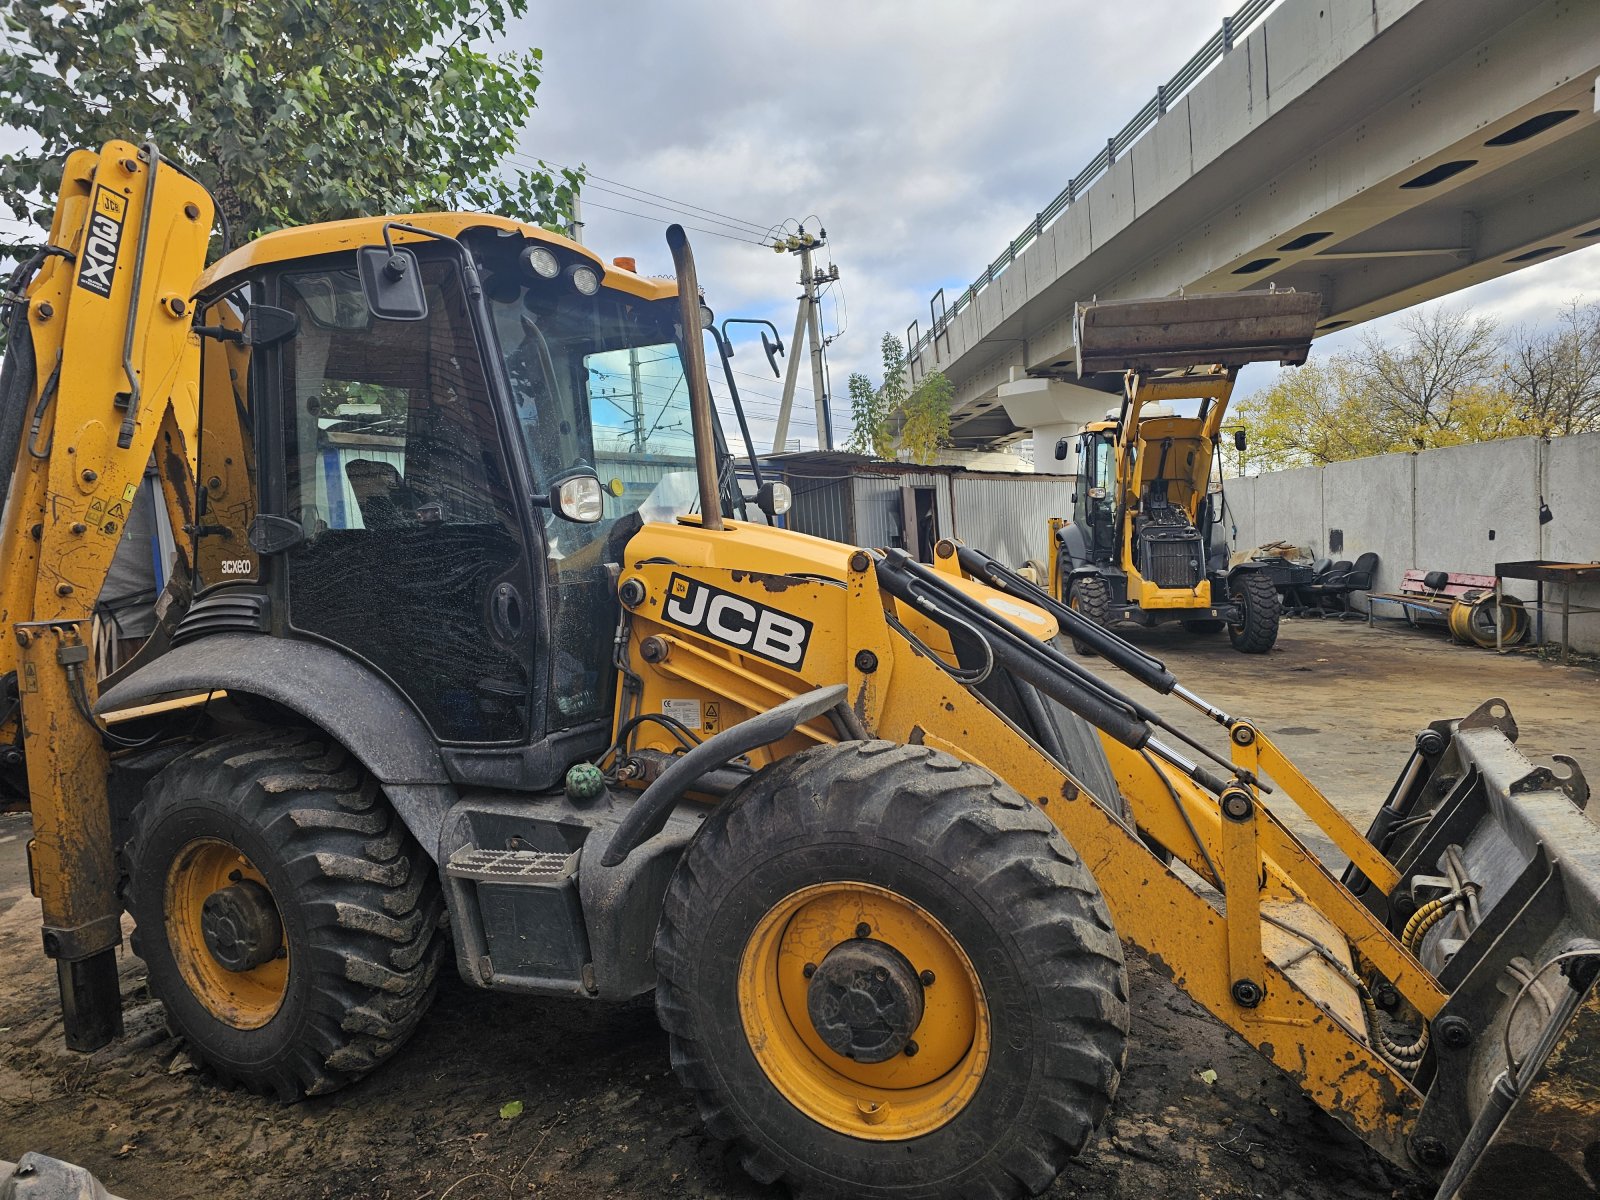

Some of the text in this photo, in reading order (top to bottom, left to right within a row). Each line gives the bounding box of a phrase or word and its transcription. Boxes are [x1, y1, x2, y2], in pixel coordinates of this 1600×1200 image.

[104, 197, 120, 212] JCB
[81, 215, 119, 286] 3CX
[667, 586, 806, 664] JCB
